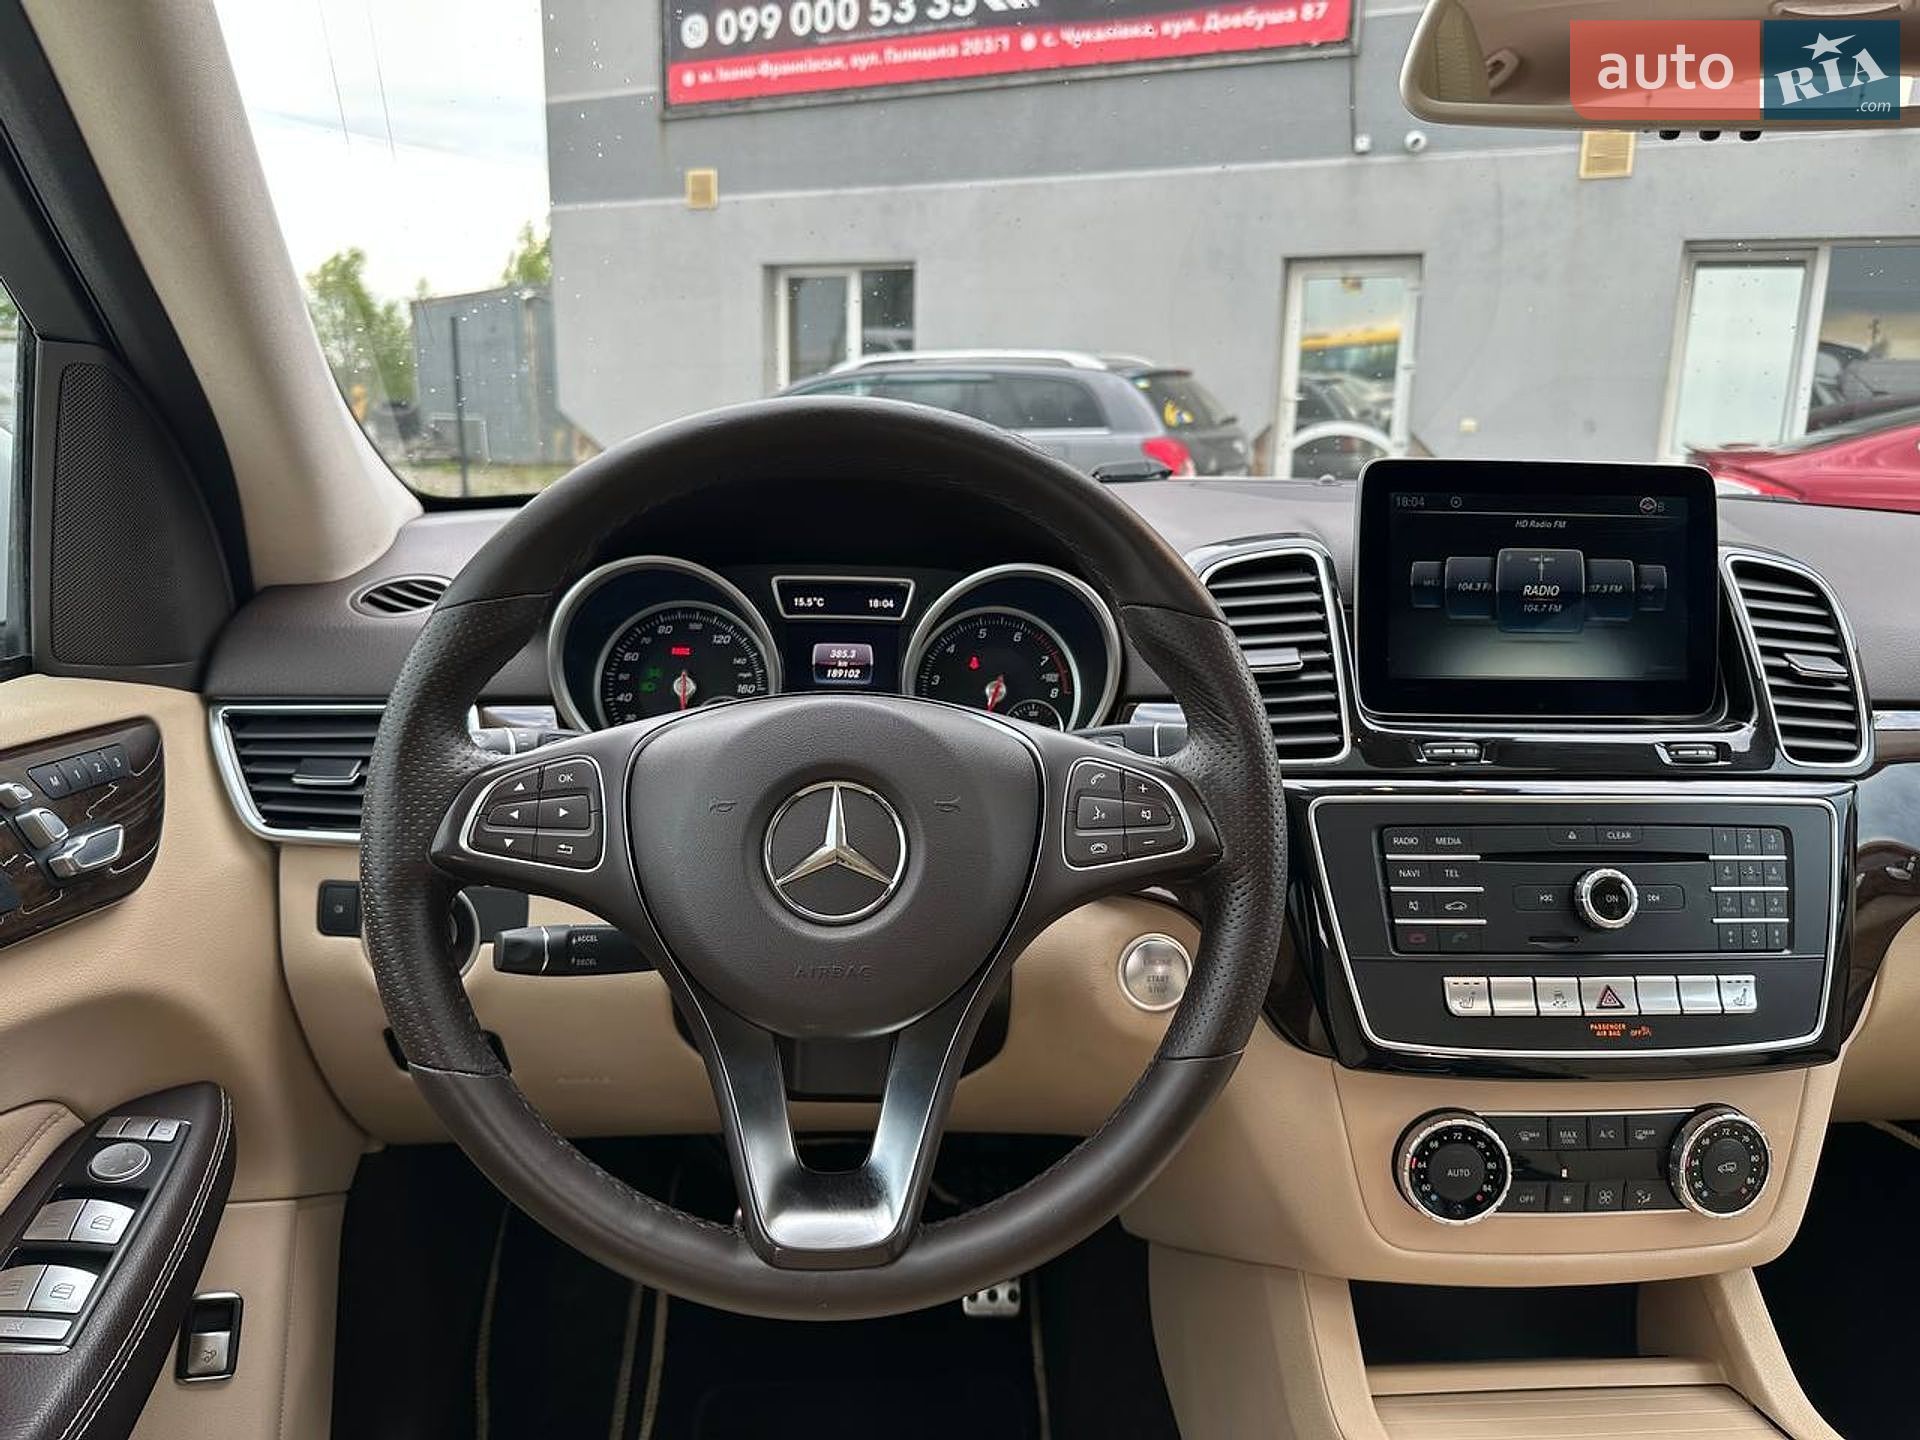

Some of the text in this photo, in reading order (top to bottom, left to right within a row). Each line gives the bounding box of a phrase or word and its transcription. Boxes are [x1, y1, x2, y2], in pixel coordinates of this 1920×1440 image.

[715, 4, 782, 46] 099
[789, 0, 860, 37] 000
[1529, 519, 1552, 528] Radio
[1523, 584, 1560, 597] RADIO
[793, 597, 825, 608] 15.5°C
[868, 598, 894, 609] 18:04
[977, 628, 987, 639] 5
[1013, 632, 1022, 643] 6
[826, 668, 861, 679] 189102
[931, 674, 940, 686] 3
[558, 773, 573, 783] OK
[1607, 831, 1632, 840] CLEAR
[1393, 836, 1418, 846] RADIO
[1435, 836, 1462, 846] MEDIA
[1399, 868, 1420, 878] NAVI
[1444, 868, 1459, 878] TEL
[1605, 894, 1619, 903] ON
[1447, 1168, 1470, 1178] AUTO
[1519, 1195, 1535, 1204] OFF
